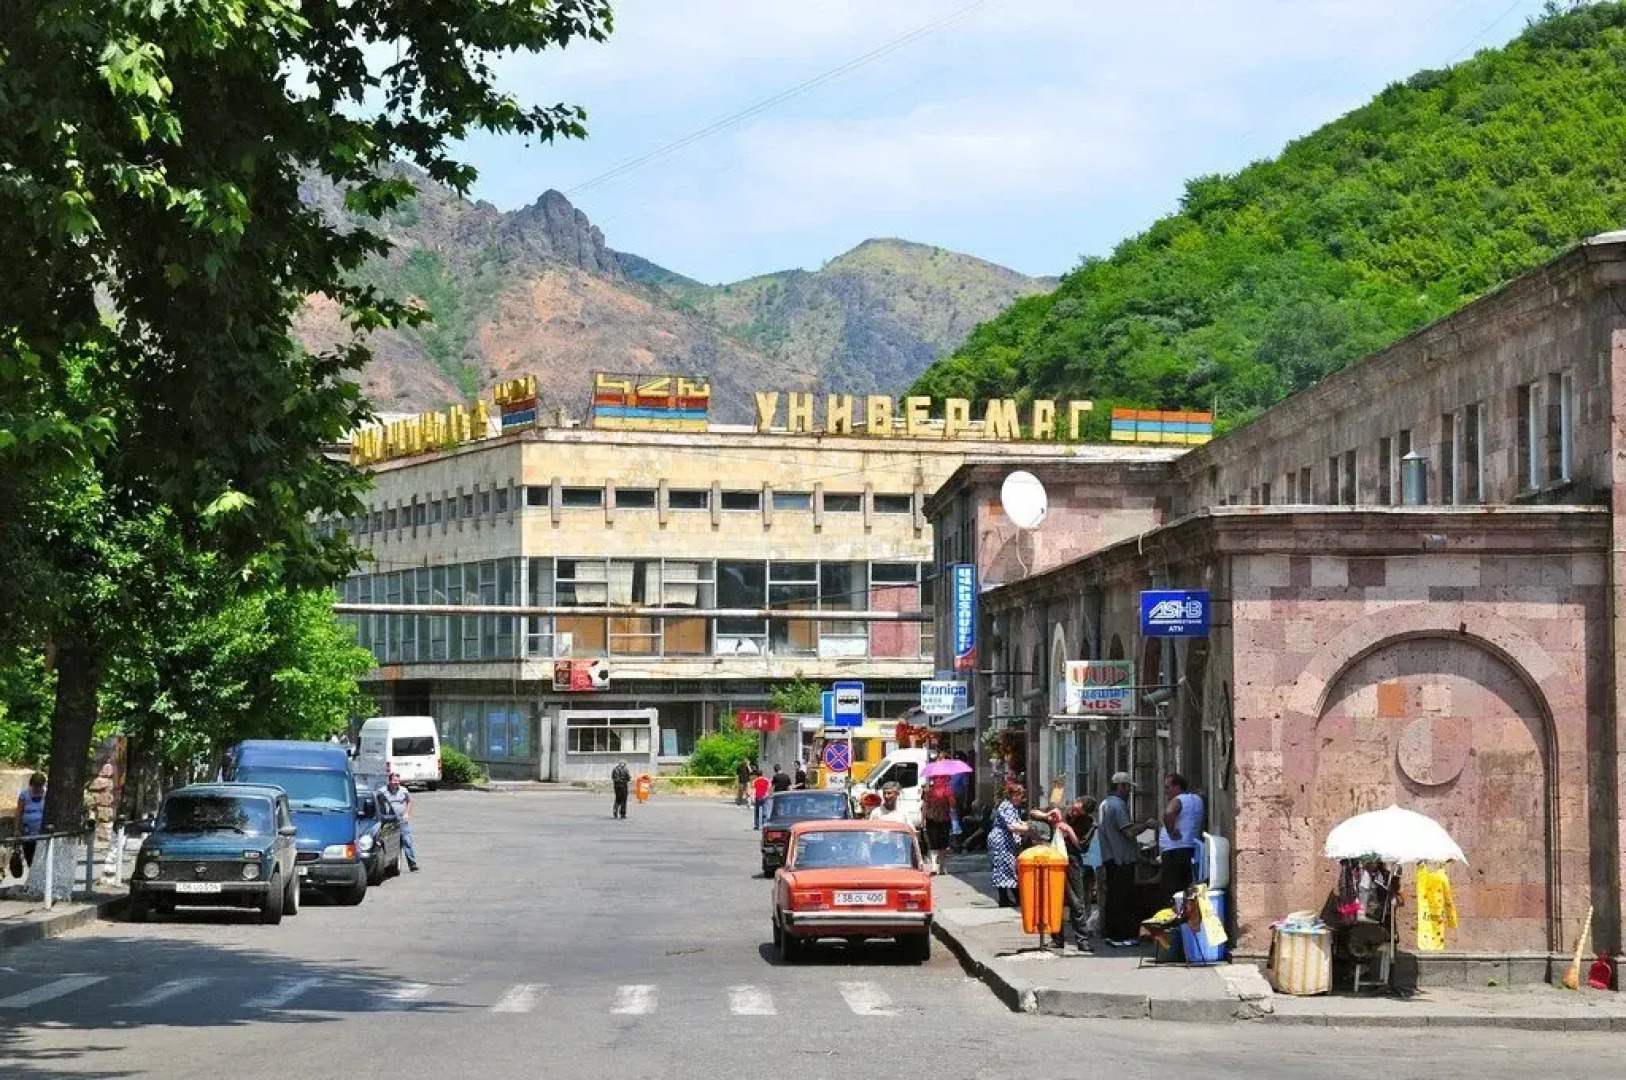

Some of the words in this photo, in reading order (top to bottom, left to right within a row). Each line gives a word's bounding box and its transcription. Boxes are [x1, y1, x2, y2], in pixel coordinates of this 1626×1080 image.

[755, 391, 1093, 440] УНИВЕРМАГ
[1168, 625, 1184, 633] ATM
[922, 683, 967, 695] Konica
